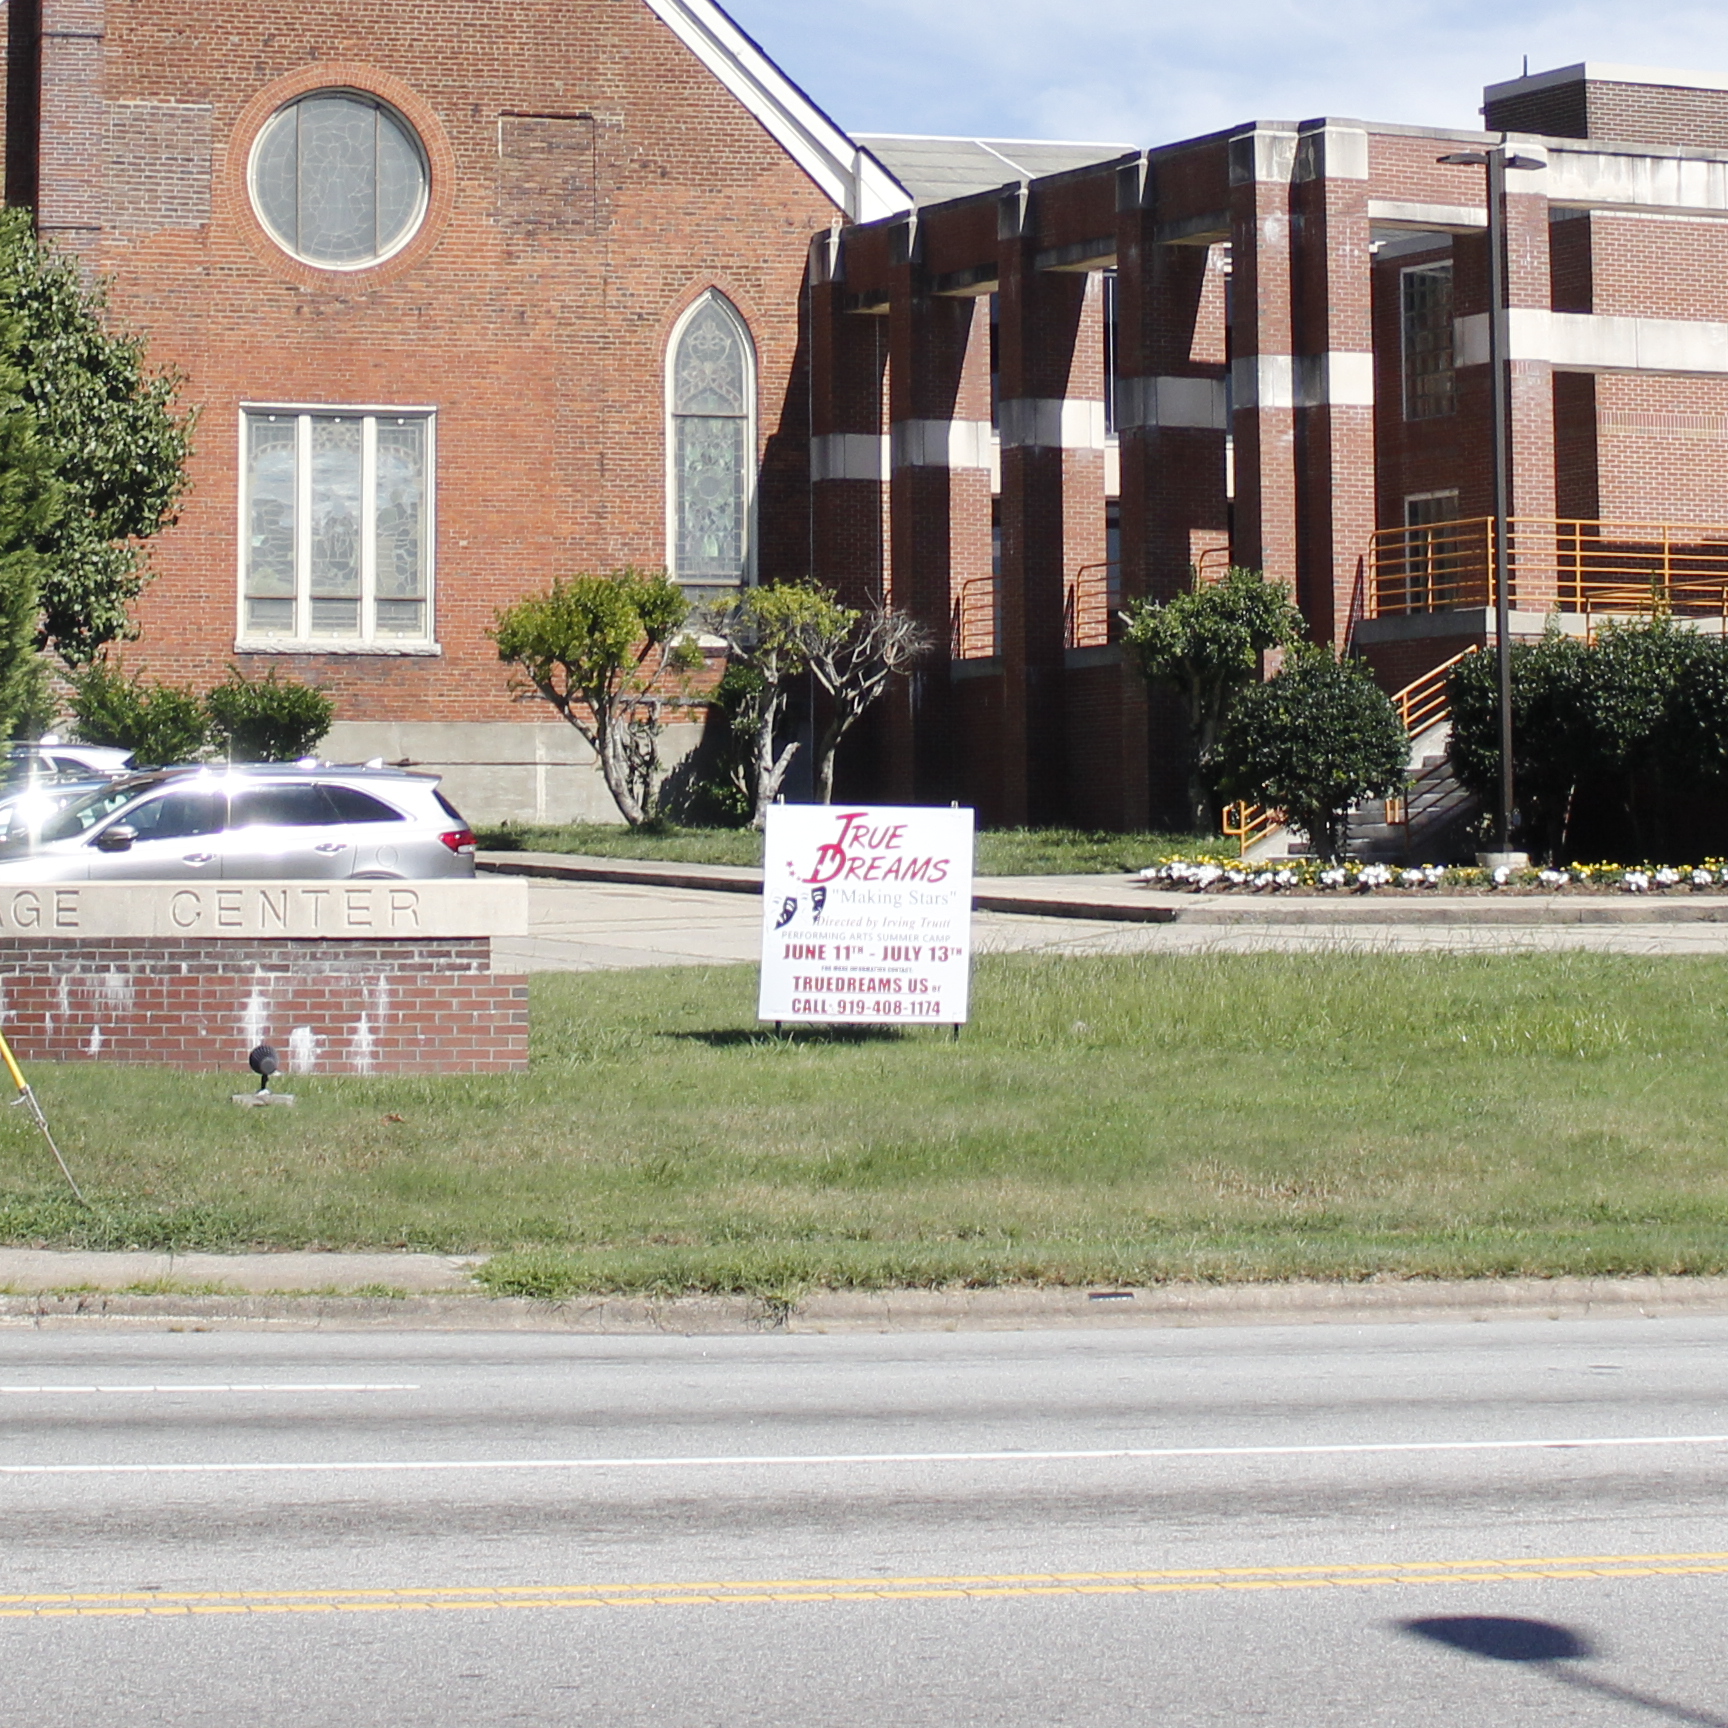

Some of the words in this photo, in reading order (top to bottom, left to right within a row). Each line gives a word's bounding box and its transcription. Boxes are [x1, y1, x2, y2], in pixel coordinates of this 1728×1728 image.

[832, 888, 903, 908] "Making
[909, 889, 957, 906] Stars"
[170, 889, 421, 929] CENTER
[817, 915, 863, 927] Directed
[866, 916, 879, 930] by
[882, 916, 916, 929] Irving
[781, 930, 846, 941] PERFORMING
[849, 931, 873, 941] ARTS
[877, 933, 919, 942] SUMMER
[922, 933, 951, 943] CAMP
[783, 943, 827, 961] JUNE
[833, 944, 864, 961] 11TH
[881, 945, 922, 962] JULY
[928, 945, 962, 962] 13TH
[837, 998, 941, 1016] 919-408-1174
